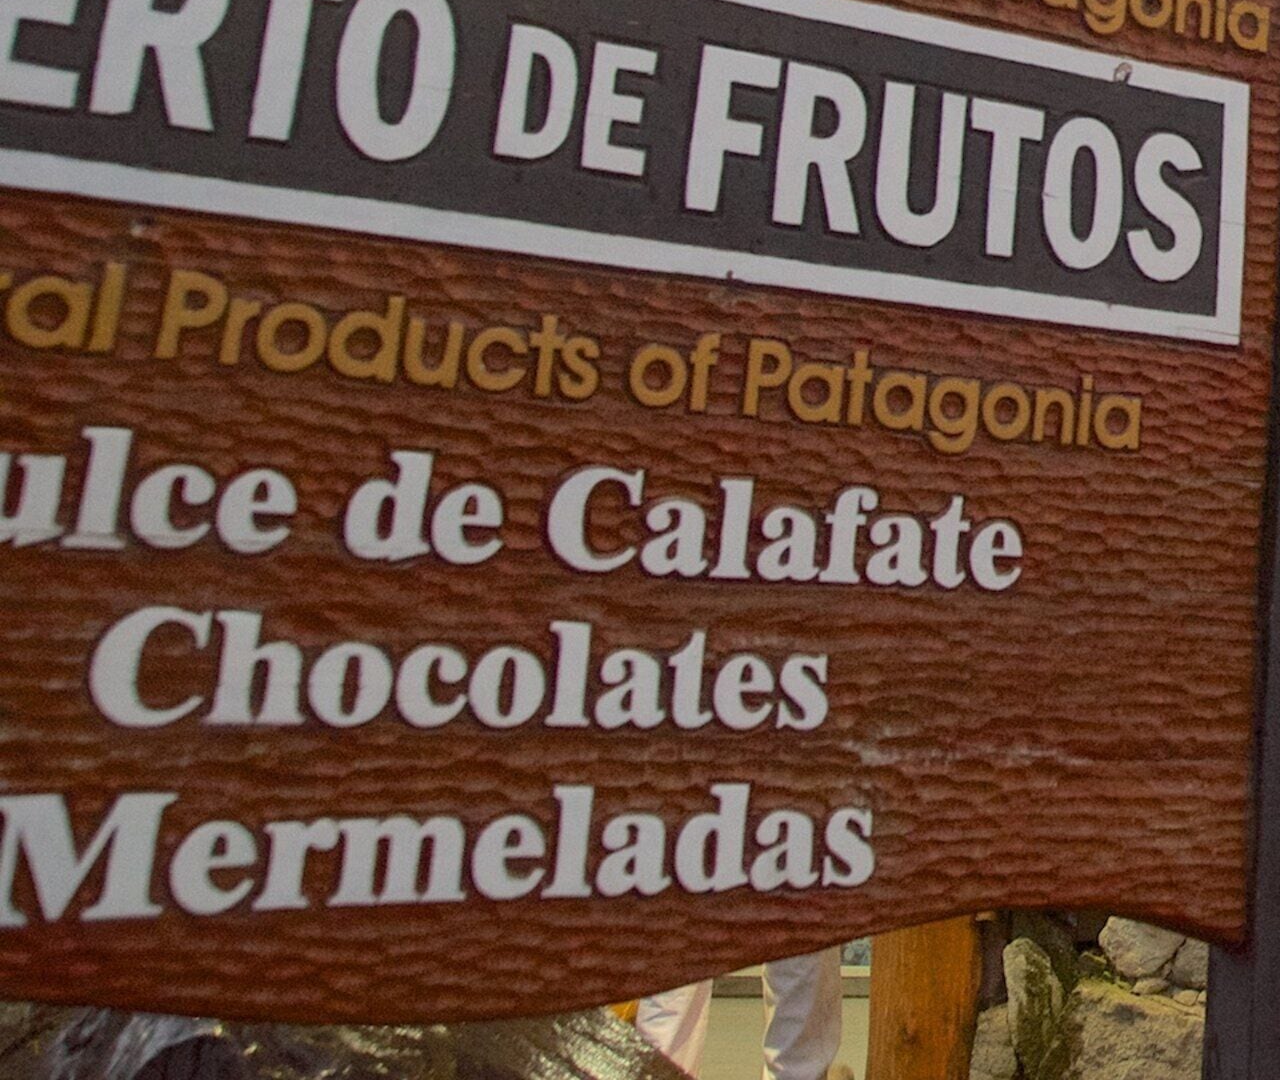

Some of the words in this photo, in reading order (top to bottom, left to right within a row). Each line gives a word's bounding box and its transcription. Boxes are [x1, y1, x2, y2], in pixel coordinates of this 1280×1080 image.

[493, 22, 658, 177] DE
[684, 43, 1203, 283] FRUTOS
[0, 262, 124, 352] al
[155, 270, 601, 400] Products
[629, 333, 721, 412] of
[742, 339, 1143, 455] Patagonia
[0, 426, 298, 554] ulce
[343, 450, 504, 565] de
[547, 466, 1024, 591] Calafate
[89, 605, 829, 731] Chocolates
[0, 782, 876, 923] Mermeladas
